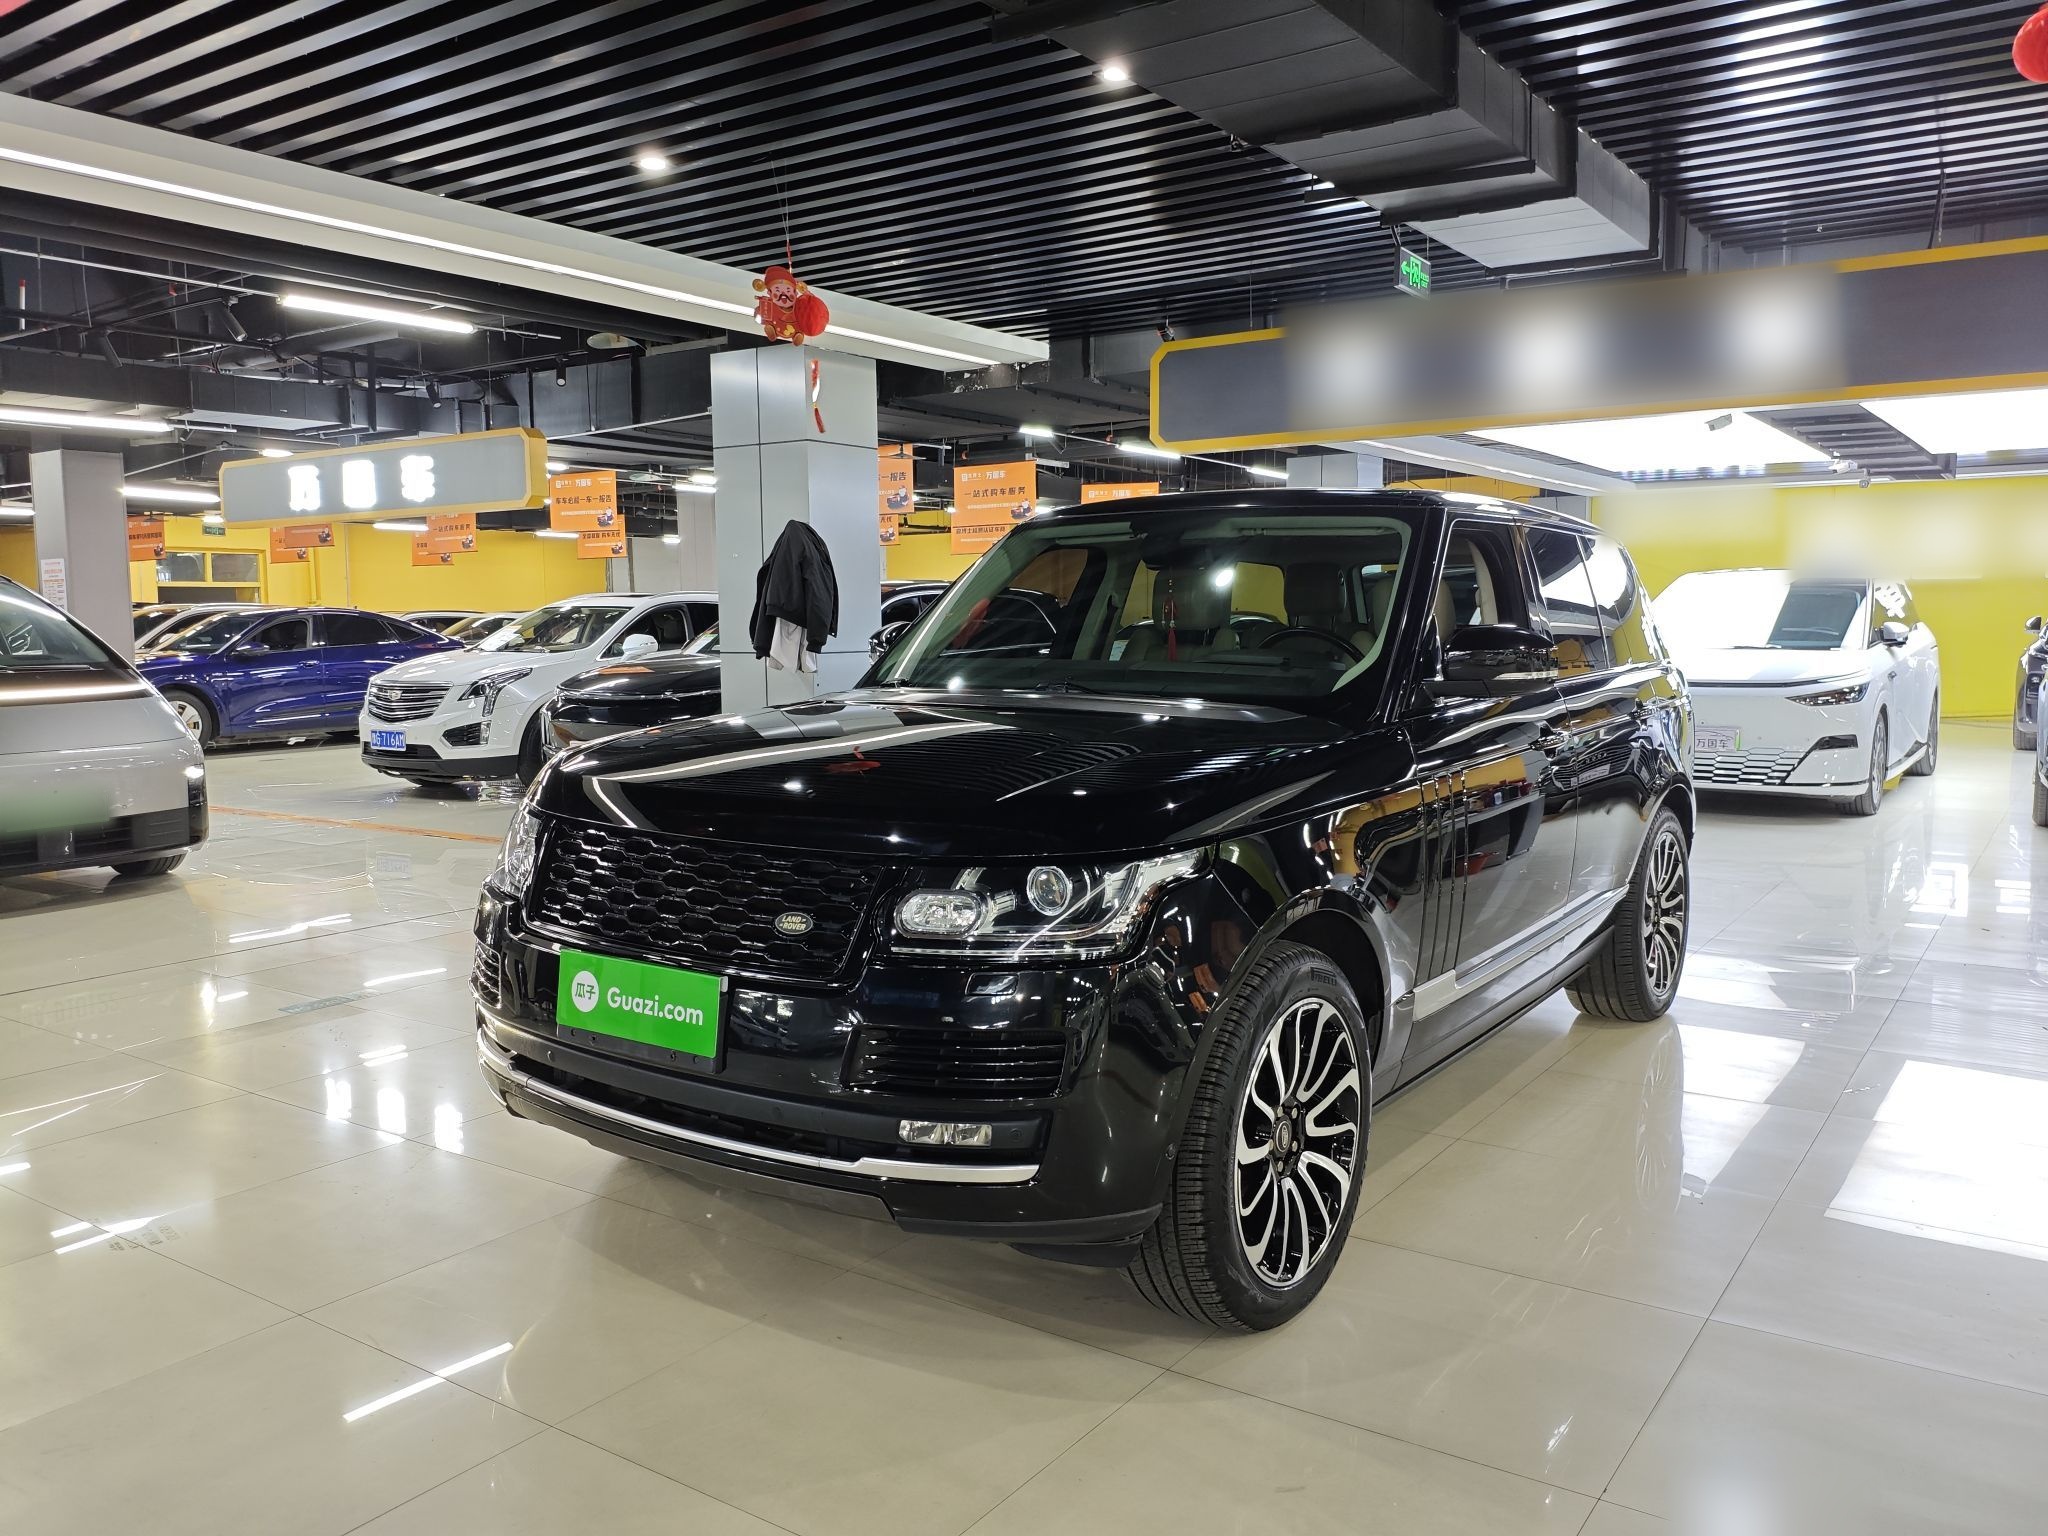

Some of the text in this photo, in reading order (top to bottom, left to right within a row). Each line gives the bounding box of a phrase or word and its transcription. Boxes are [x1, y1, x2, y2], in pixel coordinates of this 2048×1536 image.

[963, 486, 1026, 498] 一站式购车服务
[1697, 738, 1728, 749] 万国车
[782, 915, 802, 923] LAND
[782, 922, 806, 930] ROVER
[575, 982, 704, 1026] 瓜子 Guazi.com
